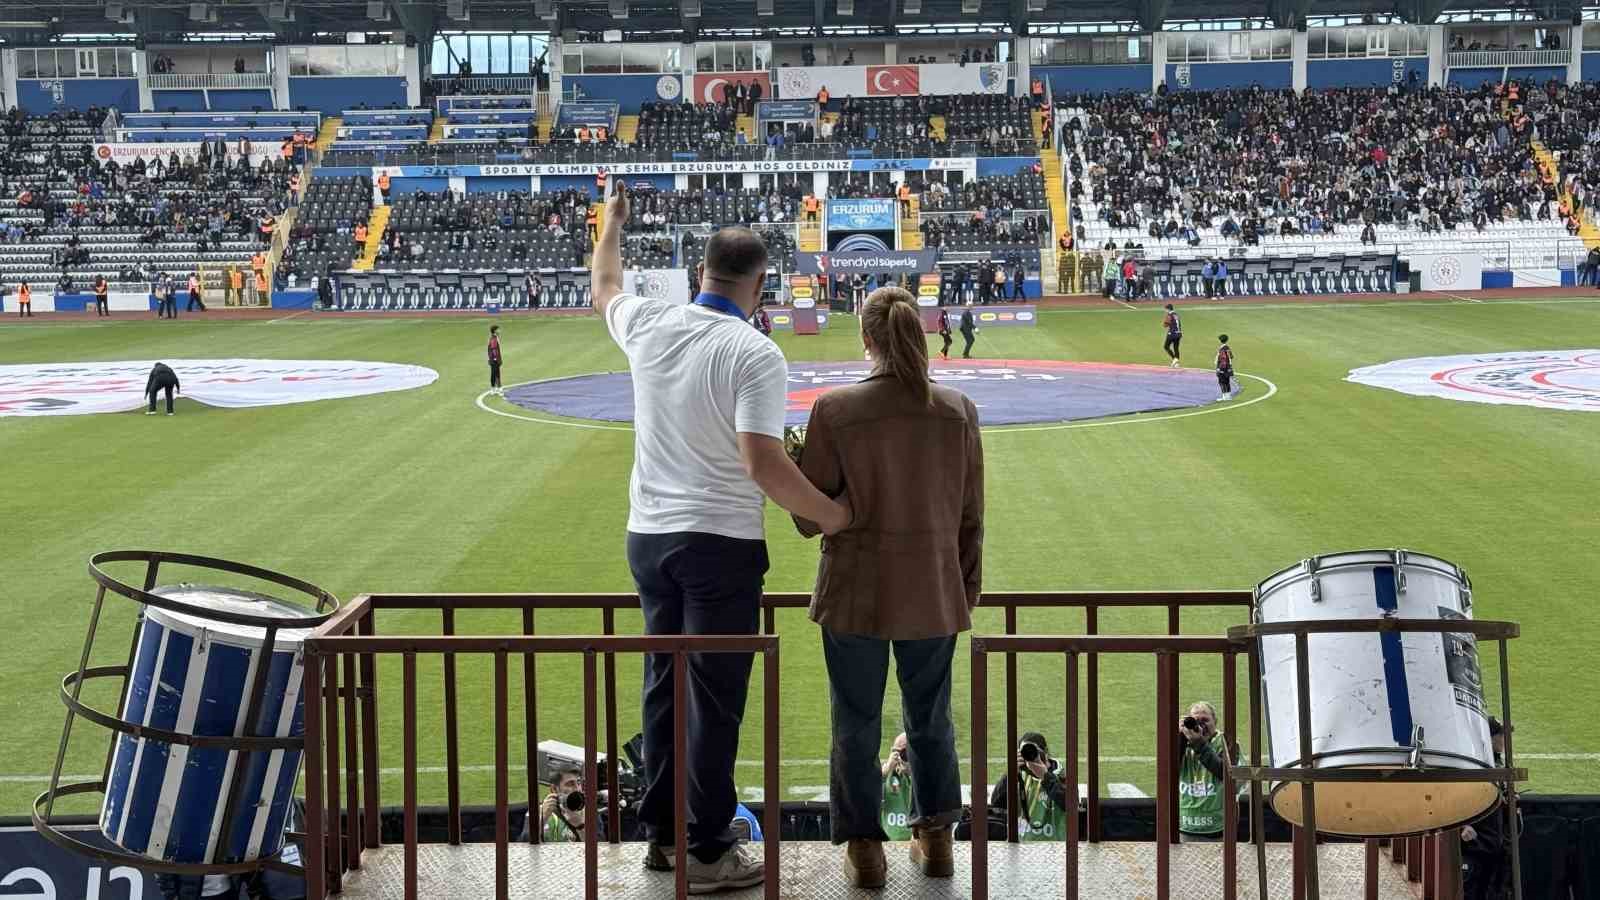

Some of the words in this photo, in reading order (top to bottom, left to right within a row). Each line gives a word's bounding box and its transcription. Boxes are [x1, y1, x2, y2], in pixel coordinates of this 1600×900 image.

[485, 166, 518, 174] SPOR
[525, 166, 542, 174] VE
[671, 163, 747, 172] ERZURUM'A
[832, 204, 889, 215] ERZURUM
[831, 256, 878, 269] trendyol
[1181, 815, 1213, 826] PRESS
